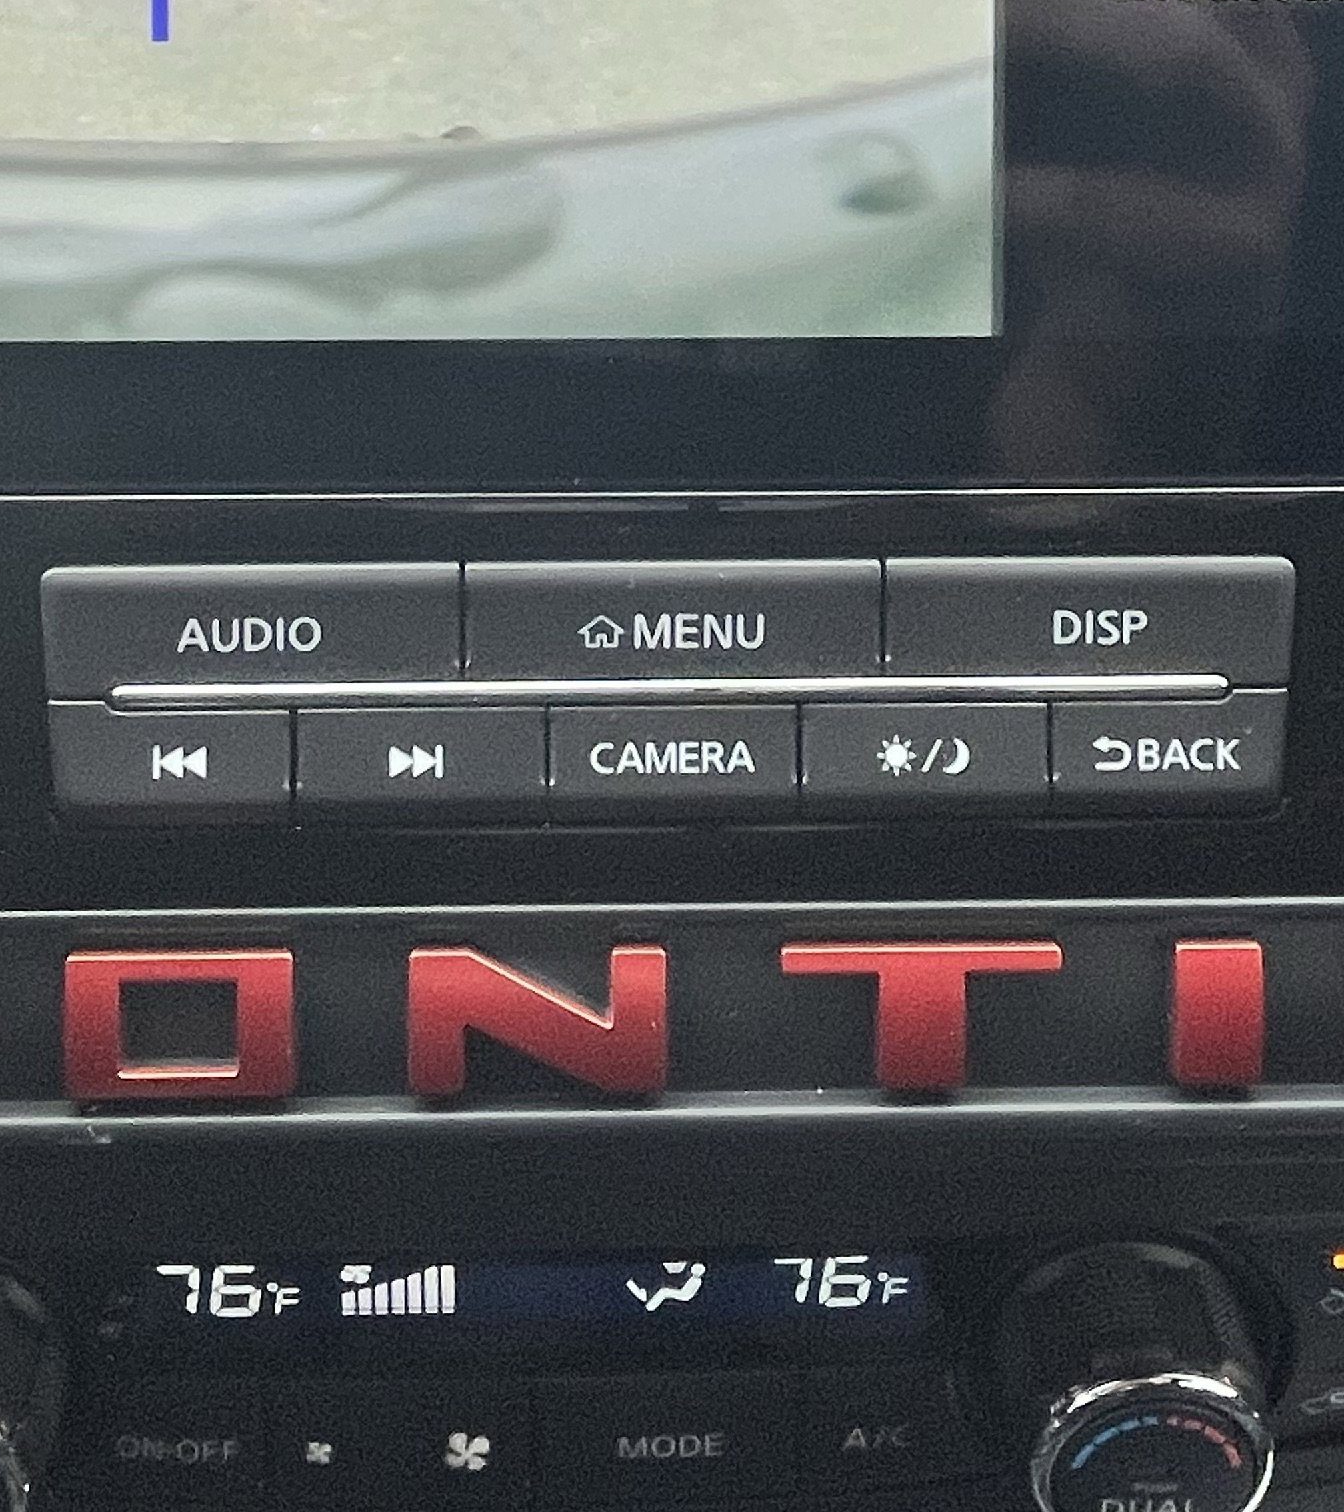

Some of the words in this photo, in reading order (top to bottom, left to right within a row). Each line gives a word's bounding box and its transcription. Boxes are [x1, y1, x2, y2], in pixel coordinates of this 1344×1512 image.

[177, 616, 322, 653] AUDIO
[633, 613, 765, 649] MENU
[1053, 609, 1148, 646] DISP
[589, 740, 756, 775] CAMERA
[1137, 738, 1242, 771] BACK
[617, 1433, 722, 1460] MODE
